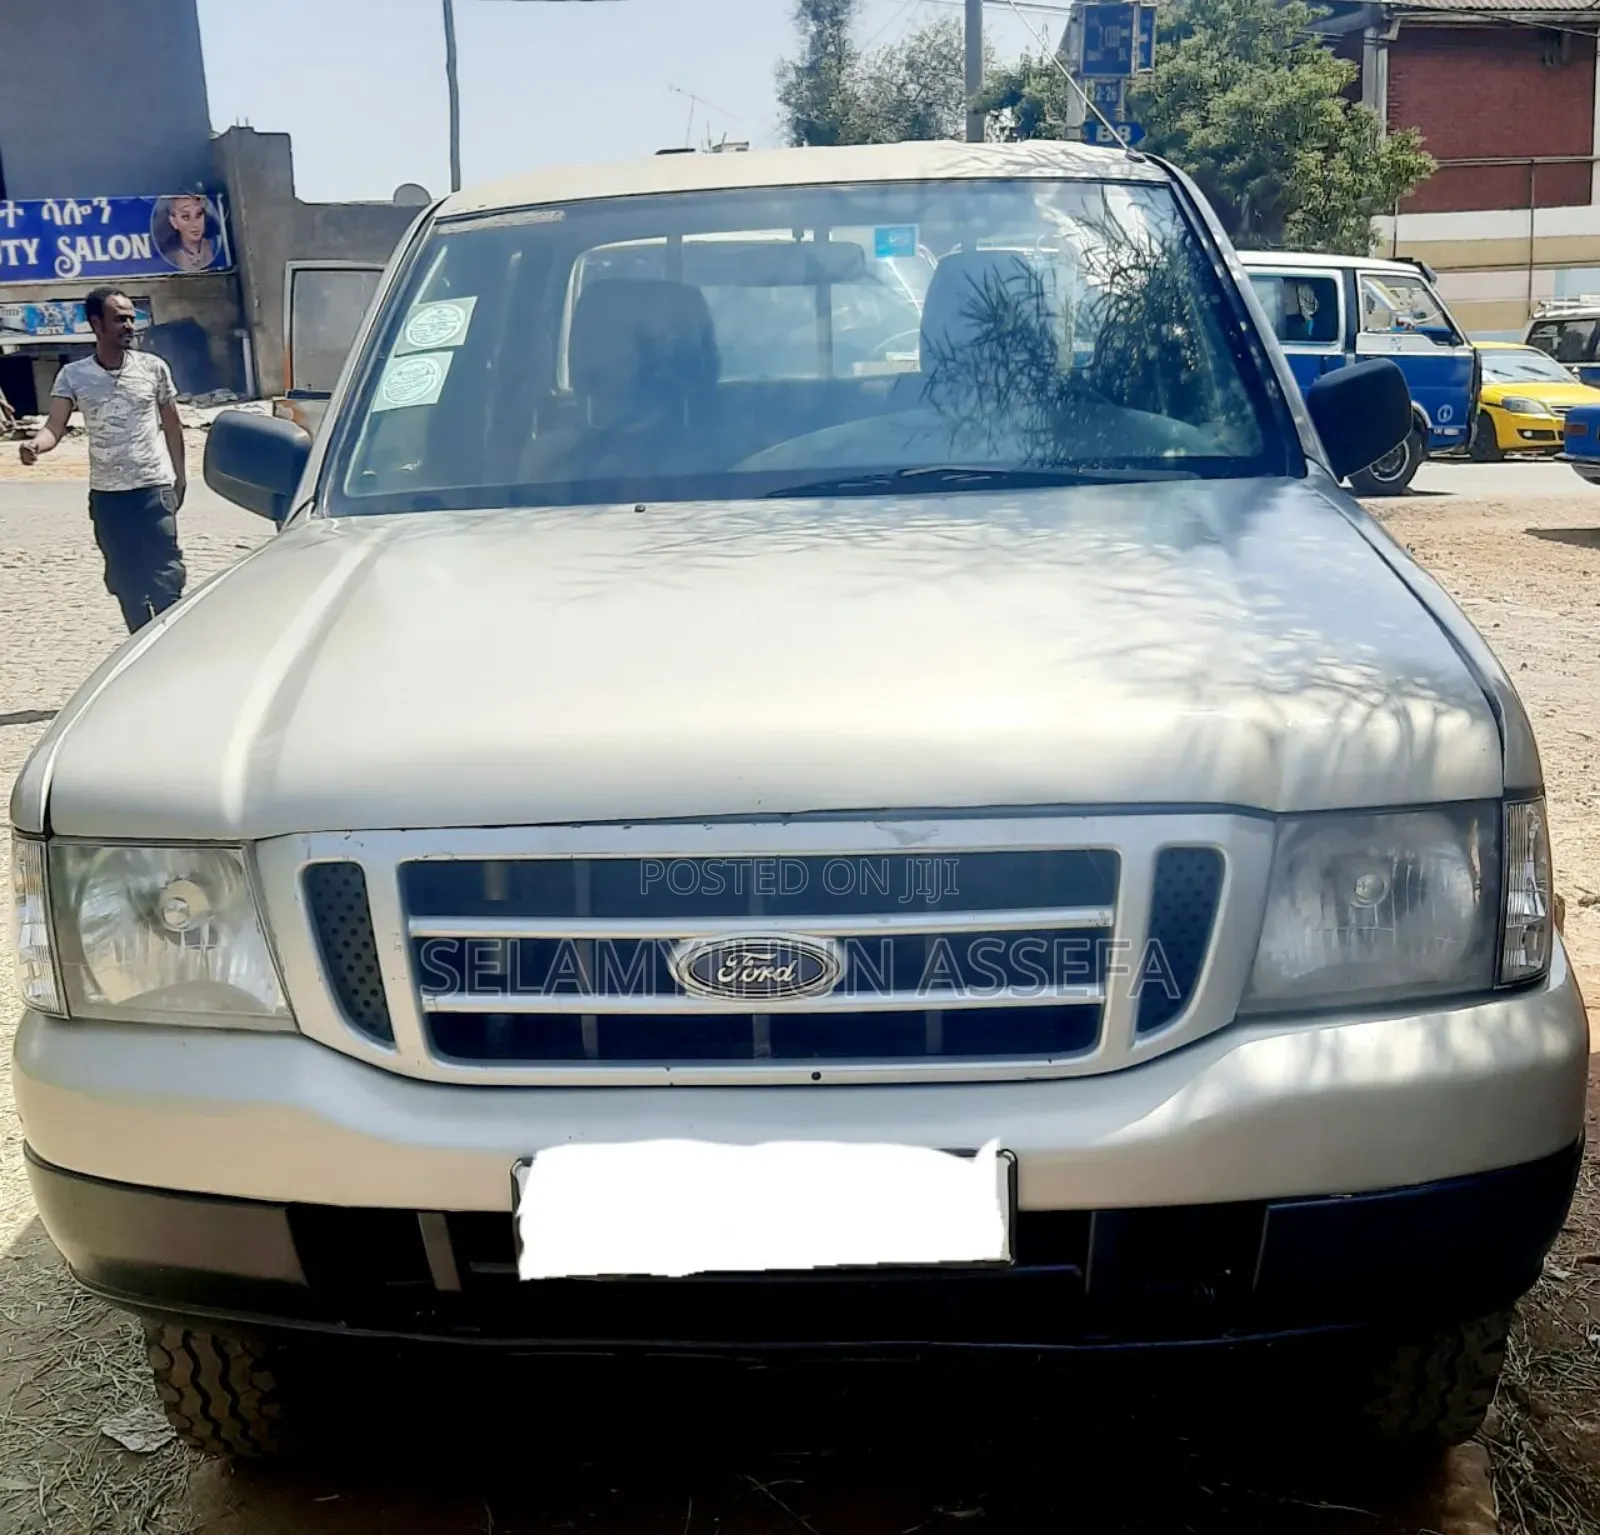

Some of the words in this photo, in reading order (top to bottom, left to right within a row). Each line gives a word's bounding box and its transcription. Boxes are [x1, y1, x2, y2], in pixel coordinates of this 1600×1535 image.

[41, 197, 112, 226] ሳሎን
[0, 238, 40, 266] TY
[54, 233, 152, 278] SALON
[717, 952, 798, 983] Ford
